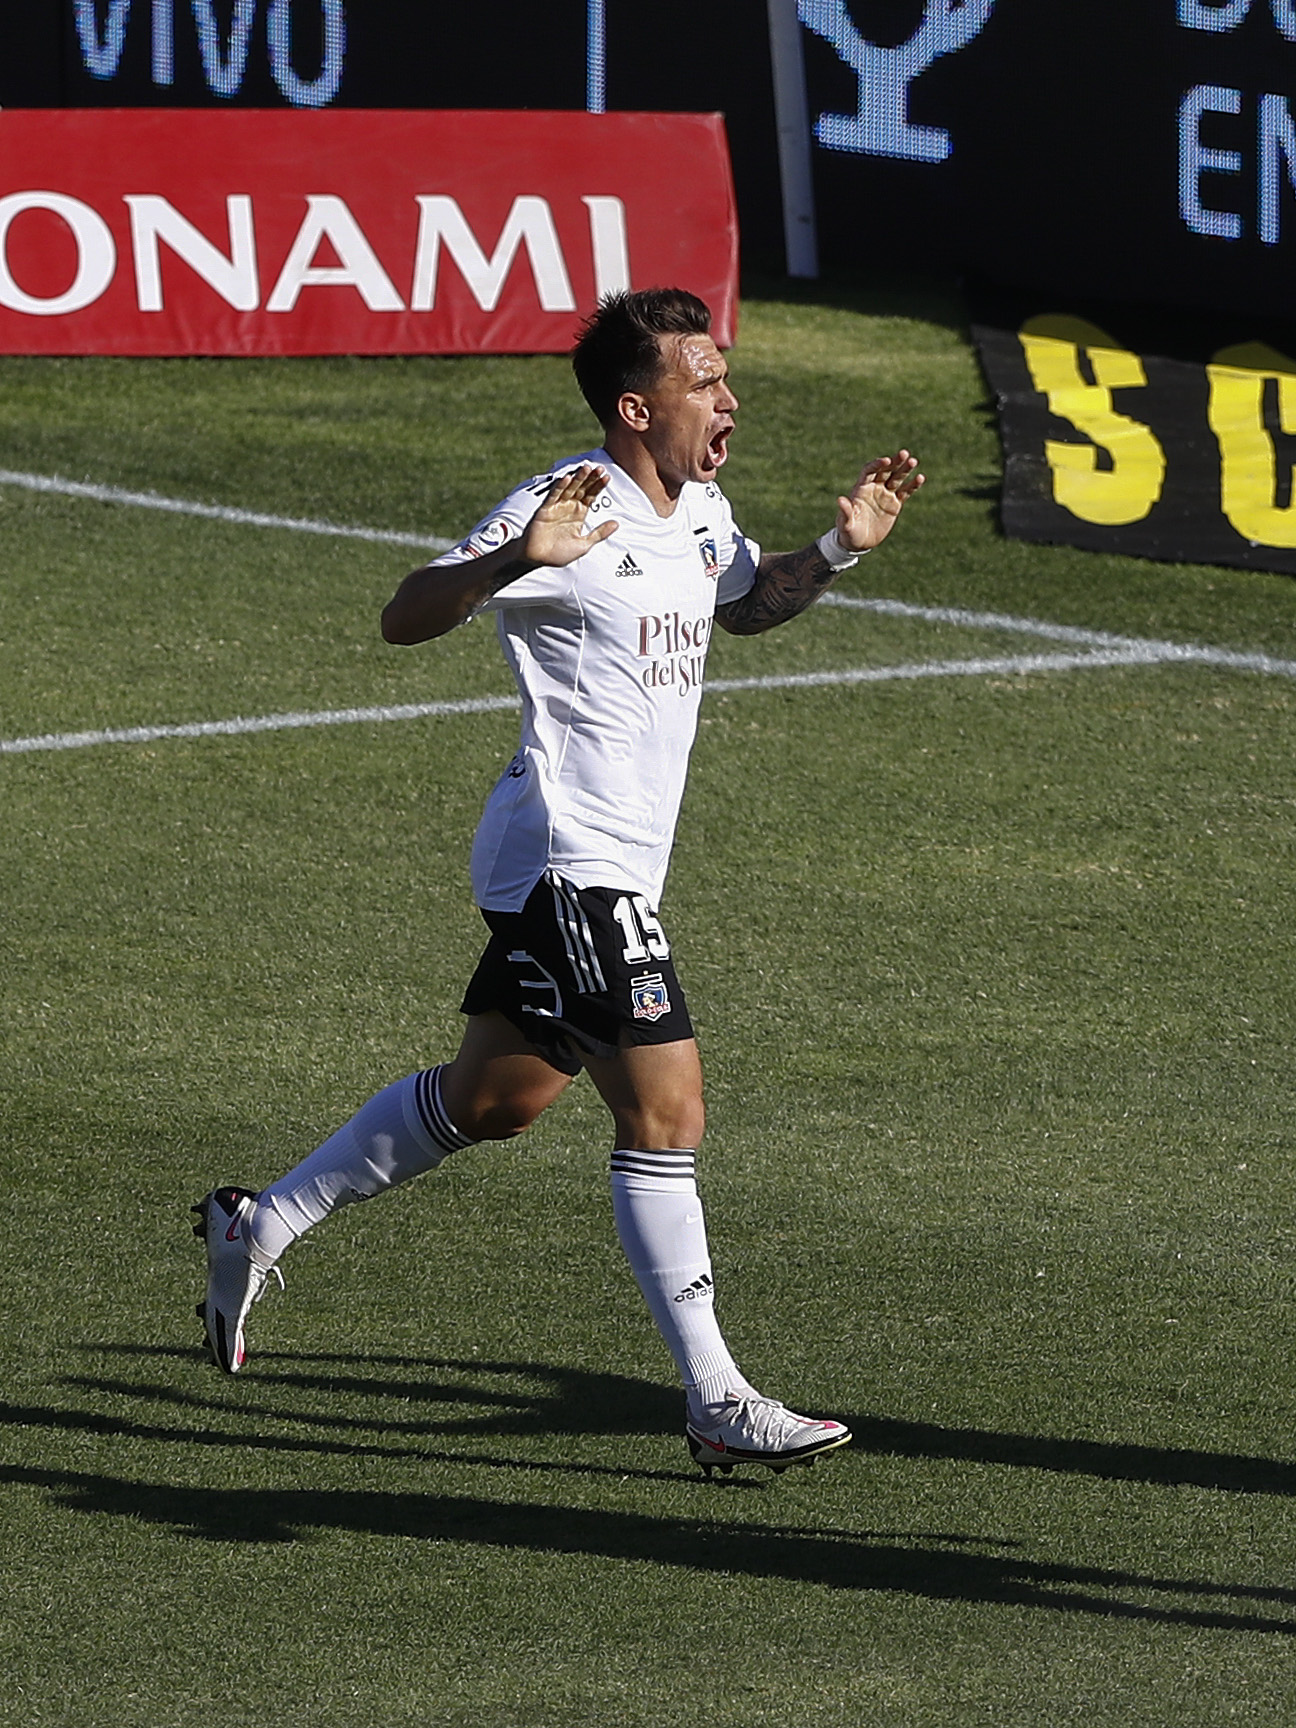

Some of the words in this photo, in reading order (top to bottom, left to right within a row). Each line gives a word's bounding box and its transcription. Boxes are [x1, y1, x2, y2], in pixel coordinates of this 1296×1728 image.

[74, 0, 346, 108] VIVO
[642, 658, 676, 688] del
[679, 654, 706, 698] Su
[613, 895, 671, 965] 15
